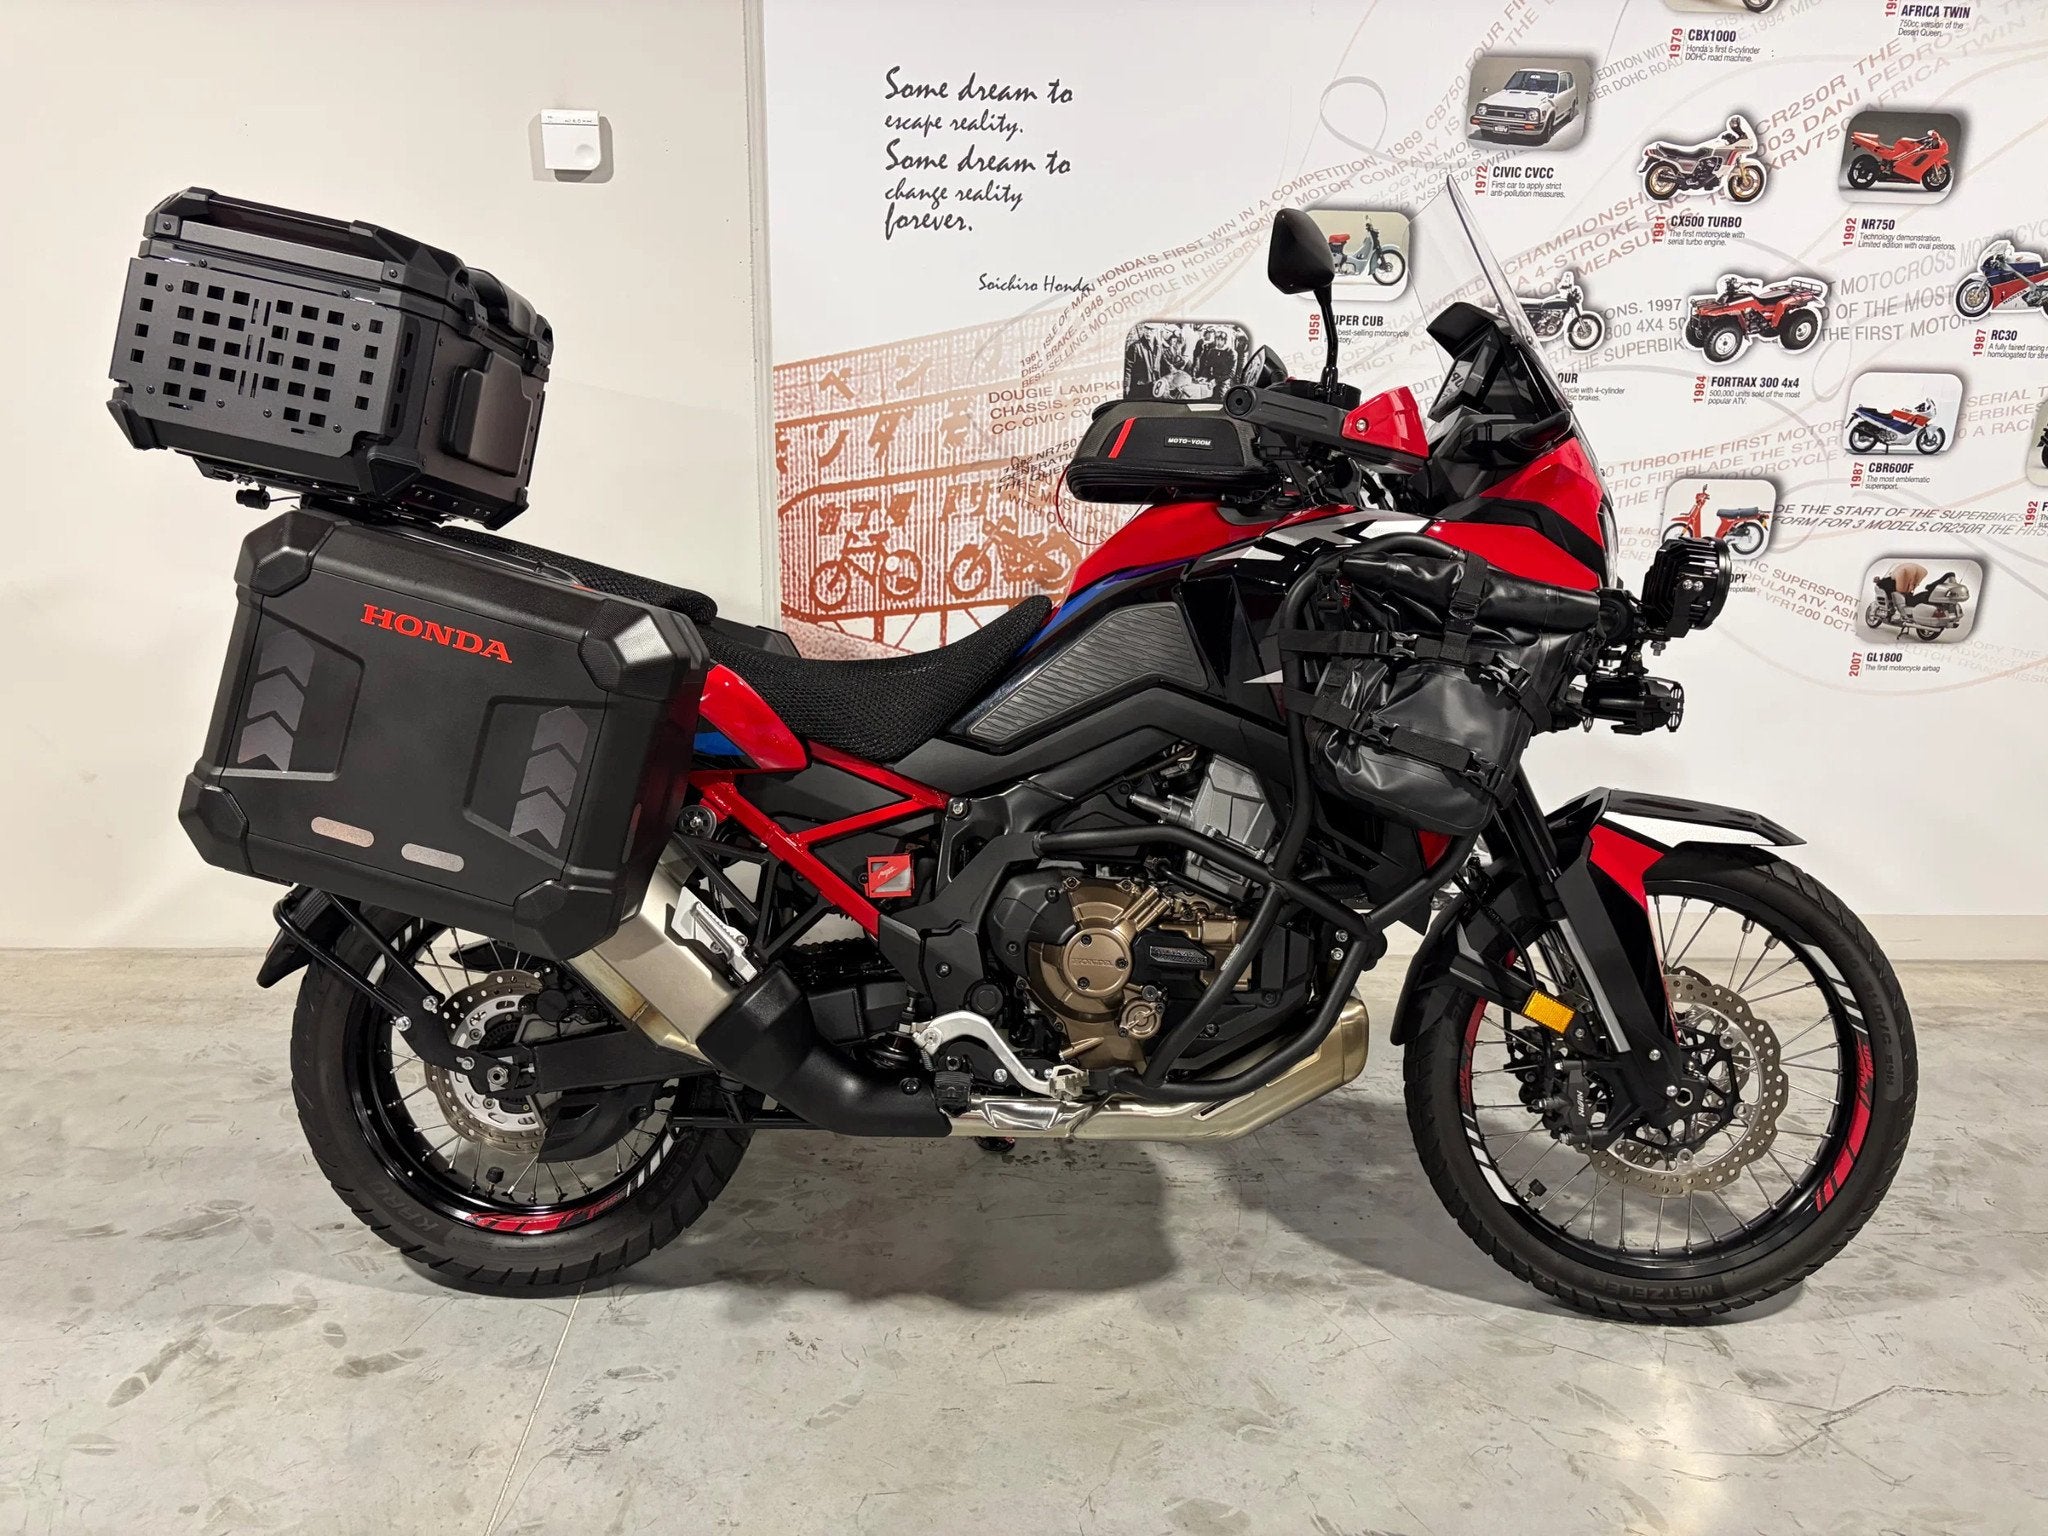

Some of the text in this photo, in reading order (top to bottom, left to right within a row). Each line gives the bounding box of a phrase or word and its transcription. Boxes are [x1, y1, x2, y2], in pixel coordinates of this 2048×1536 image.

[1901, 5, 1940, 17] AFRICA
[1943, 6, 1971, 19] TWIN
[1688, 29, 1737, 42] CBX1000
[1898, 28, 1919, 36] Desert
[1669, 28, 1683, 59] 1979
[1686, 45, 1713, 53] Honda's
[1715, 45, 1727, 53] first
[1685, 53, 1706, 61] DOHC
[1852, 37, 1907, 77] THE
[1596, 54, 1643, 81] EDITION
[885, 66, 1074, 104] Some dream to
[1803, 88, 1862, 132] DANI
[885, 109, 1024, 142] escape reality.
[885, 138, 1071, 175] Some dream to
[1475, 165, 1488, 196] 1972
[1492, 166, 1554, 179] CIVIC CVCC
[885, 177, 1024, 212] change reality
[1491, 181, 1505, 189] First
[1518, 182, 1526, 190] to
[1527, 182, 1545, 191] apply
[1545, 182, 1562, 190] strict
[1043, 326, 1059, 350] ISLE
[1058, 307, 1074, 327] OF
[1096, 254, 1159, 286] HONDA'S
[1162, 238, 1204, 261] FIRST
[1208, 219, 1237, 241] WIN
[1239, 207, 1255, 222] IN
[1258, 200, 1270, 211] A
[1386, 130, 1423, 158] 1969
[1426, 75, 1466, 131] CB750
[885, 202, 973, 241] forever.
[1652, 216, 1666, 244] 1981
[1671, 215, 1742, 228] CX500 TURBO
[1861, 219, 1895, 230] NR750
[1682, 230, 1694, 238] first
[1695, 231, 1731, 239] motorcycle
[1732, 231, 1745, 239] with
[1843, 218, 1857, 246] 1992
[1860, 232, 1895, 242] Technology
[1685, 238, 1703, 246] turbo
[1704, 239, 1727, 247] engine.
[1858, 241, 1879, 249] Limited
[1020, 360, 1043, 378] DISC
[1080, 294, 1104, 322] 1948
[1107, 263, 1176, 298] SOICHIRO
[1182, 238, 1235, 269] HONDA
[1295, 179, 1354, 206] MOTOR
[1360, 137, 1441, 185] COMPANY
[1841, 251, 1955, 295] MOTOCROSS
[978, 273, 1091, 292] Soichiro Honda
[1089, 278, 1182, 334] MOTORCYCLE
[1648, 299, 1682, 312] 1997
[1836, 303, 1858, 320] OF
[1864, 300, 1898, 318] THE
[1308, 313, 1321, 342] 1958
[1362, 315, 1384, 327] CUB
[1637, 318, 1664, 333] 4X4
[1374, 330, 1409, 339] motorcycle
[1855, 324, 1904, 341] FIRST
[1991, 330, 2018, 341] RC30
[1972, 329, 1986, 357] 1987
[1995, 343, 2007, 351] fully
[1694, 375, 1706, 402] 1984
[1711, 376, 1800, 388] FORTRAX 300 4x4
[988, 386, 1053, 404] DOUGIE
[1708, 397, 1732, 406] popular
[1709, 390, 1735, 398] 500,000
[1966, 389, 2031, 407] SERIAL
[1721, 434, 1772, 454] FIRST
[1752, 447, 1784, 462] THE
[1850, 462, 1864, 488] 1987
[1869, 463, 1914, 473] CBR600F
[1866, 475, 1878, 483] The
[1800, 504, 1831, 515] THE
[1833, 505, 1884, 516] START
[1885, 507, 1907, 517] OF
[1908, 508, 1938, 519] THE
[2024, 501, 2038, 527] 1992
[1818, 518, 1851, 529] FOR
[1852, 519, 1863, 529] 3
[1987, 524, 2018, 535] THE
[360, 603, 513, 664] HONDA
[1848, 652, 1862, 677] 2007
[1866, 652, 1903, 663] GL1800
[1889, 665, 1921, 673] motorcycle
[1071, 958, 1114, 968] HONDA
